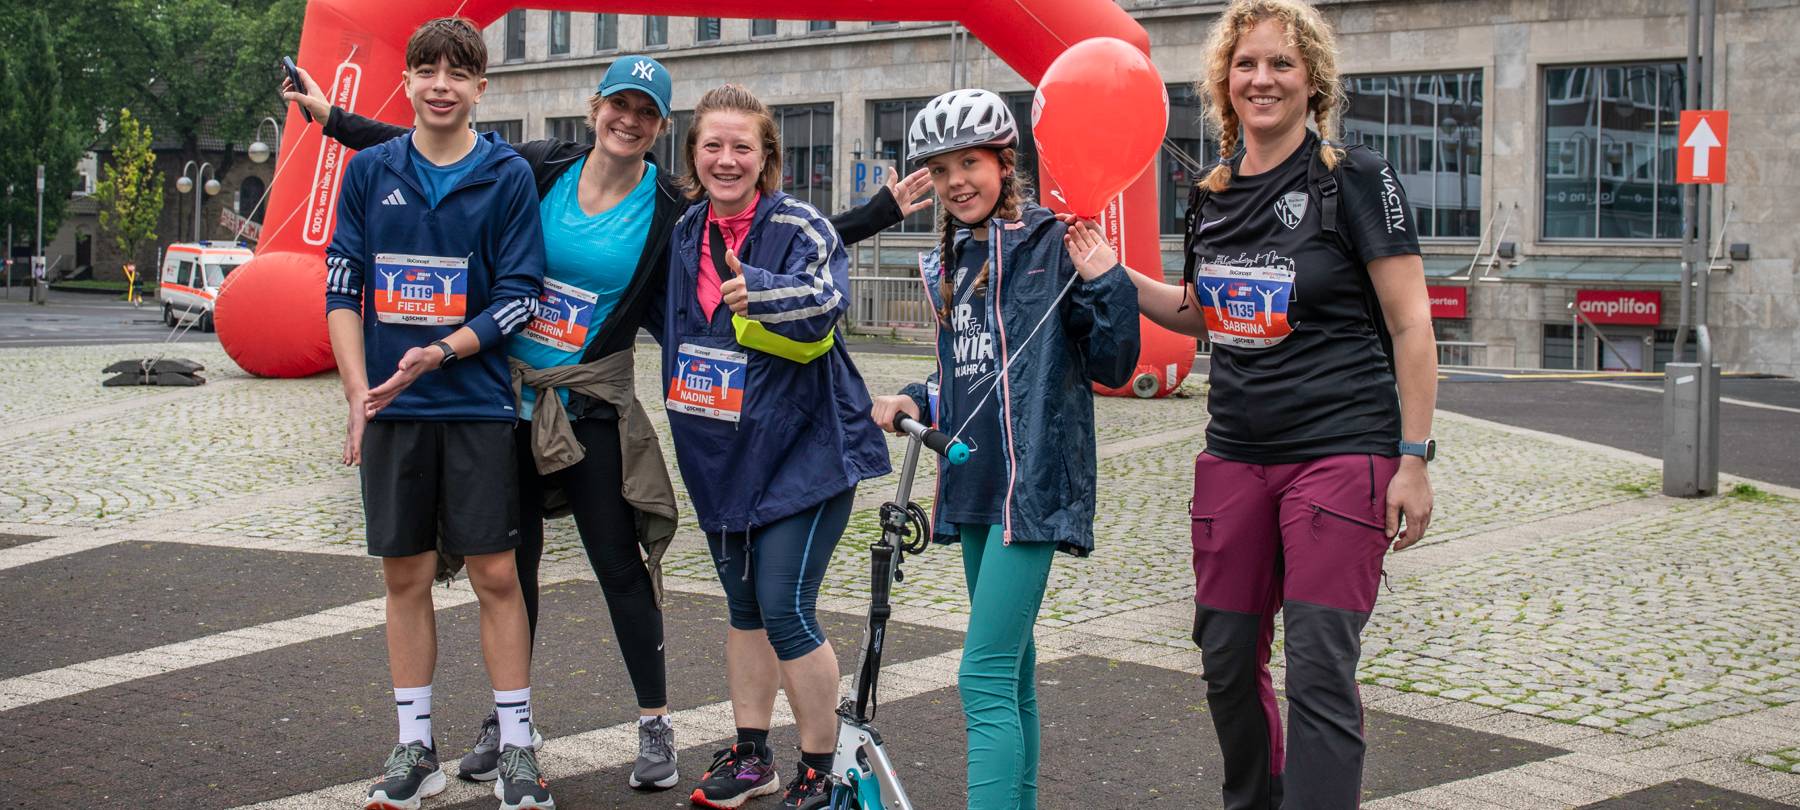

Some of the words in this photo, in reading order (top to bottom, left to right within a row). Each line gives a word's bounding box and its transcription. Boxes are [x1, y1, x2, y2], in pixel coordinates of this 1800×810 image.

[631, 60, 655, 81] NY
[1380, 166, 1406, 232] VIACTIV
[312, 207, 325, 235] 100%
[319, 189, 329, 206] von
[1110, 219, 1118, 235] von
[403, 286, 432, 298] 1119
[397, 301, 436, 313] FIETJE
[538, 306, 559, 322] 120
[1228, 302, 1254, 318] 1135
[1579, 297, 1657, 317] amplifon
[1223, 319, 1265, 335] SABRINA
[953, 332, 994, 364] WIR
[979, 362, 986, 374] 4
[687, 376, 711, 391] 1117
[681, 390, 715, 405] NADINE
